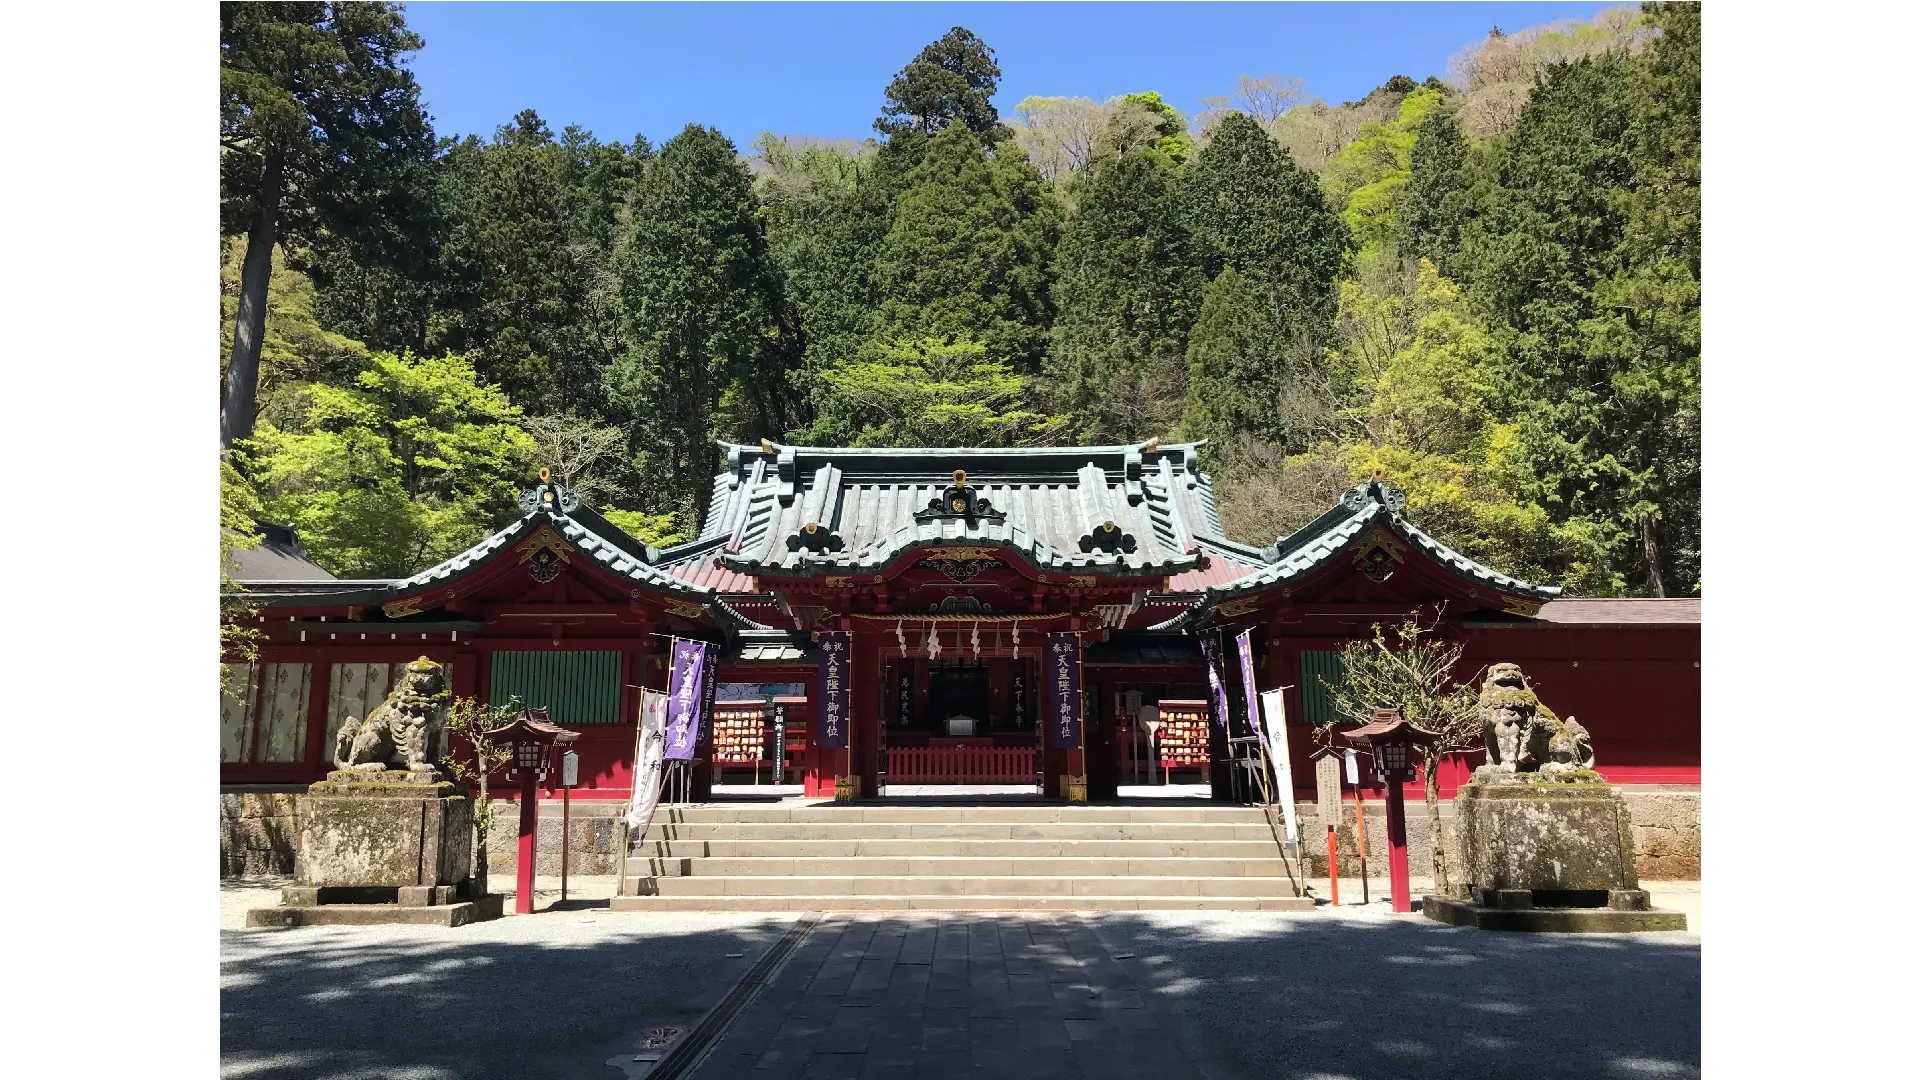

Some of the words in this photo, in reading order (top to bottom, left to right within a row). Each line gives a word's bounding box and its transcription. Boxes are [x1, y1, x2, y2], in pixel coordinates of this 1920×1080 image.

[823, 641, 844, 652] 奉祝
[1052, 642, 1074, 653] 奉祝
[826, 653, 840, 737] 天皇陛下御即位
[1057, 654, 1072, 738] 天皇陛下御即位
[649, 729, 663, 773] 令和
